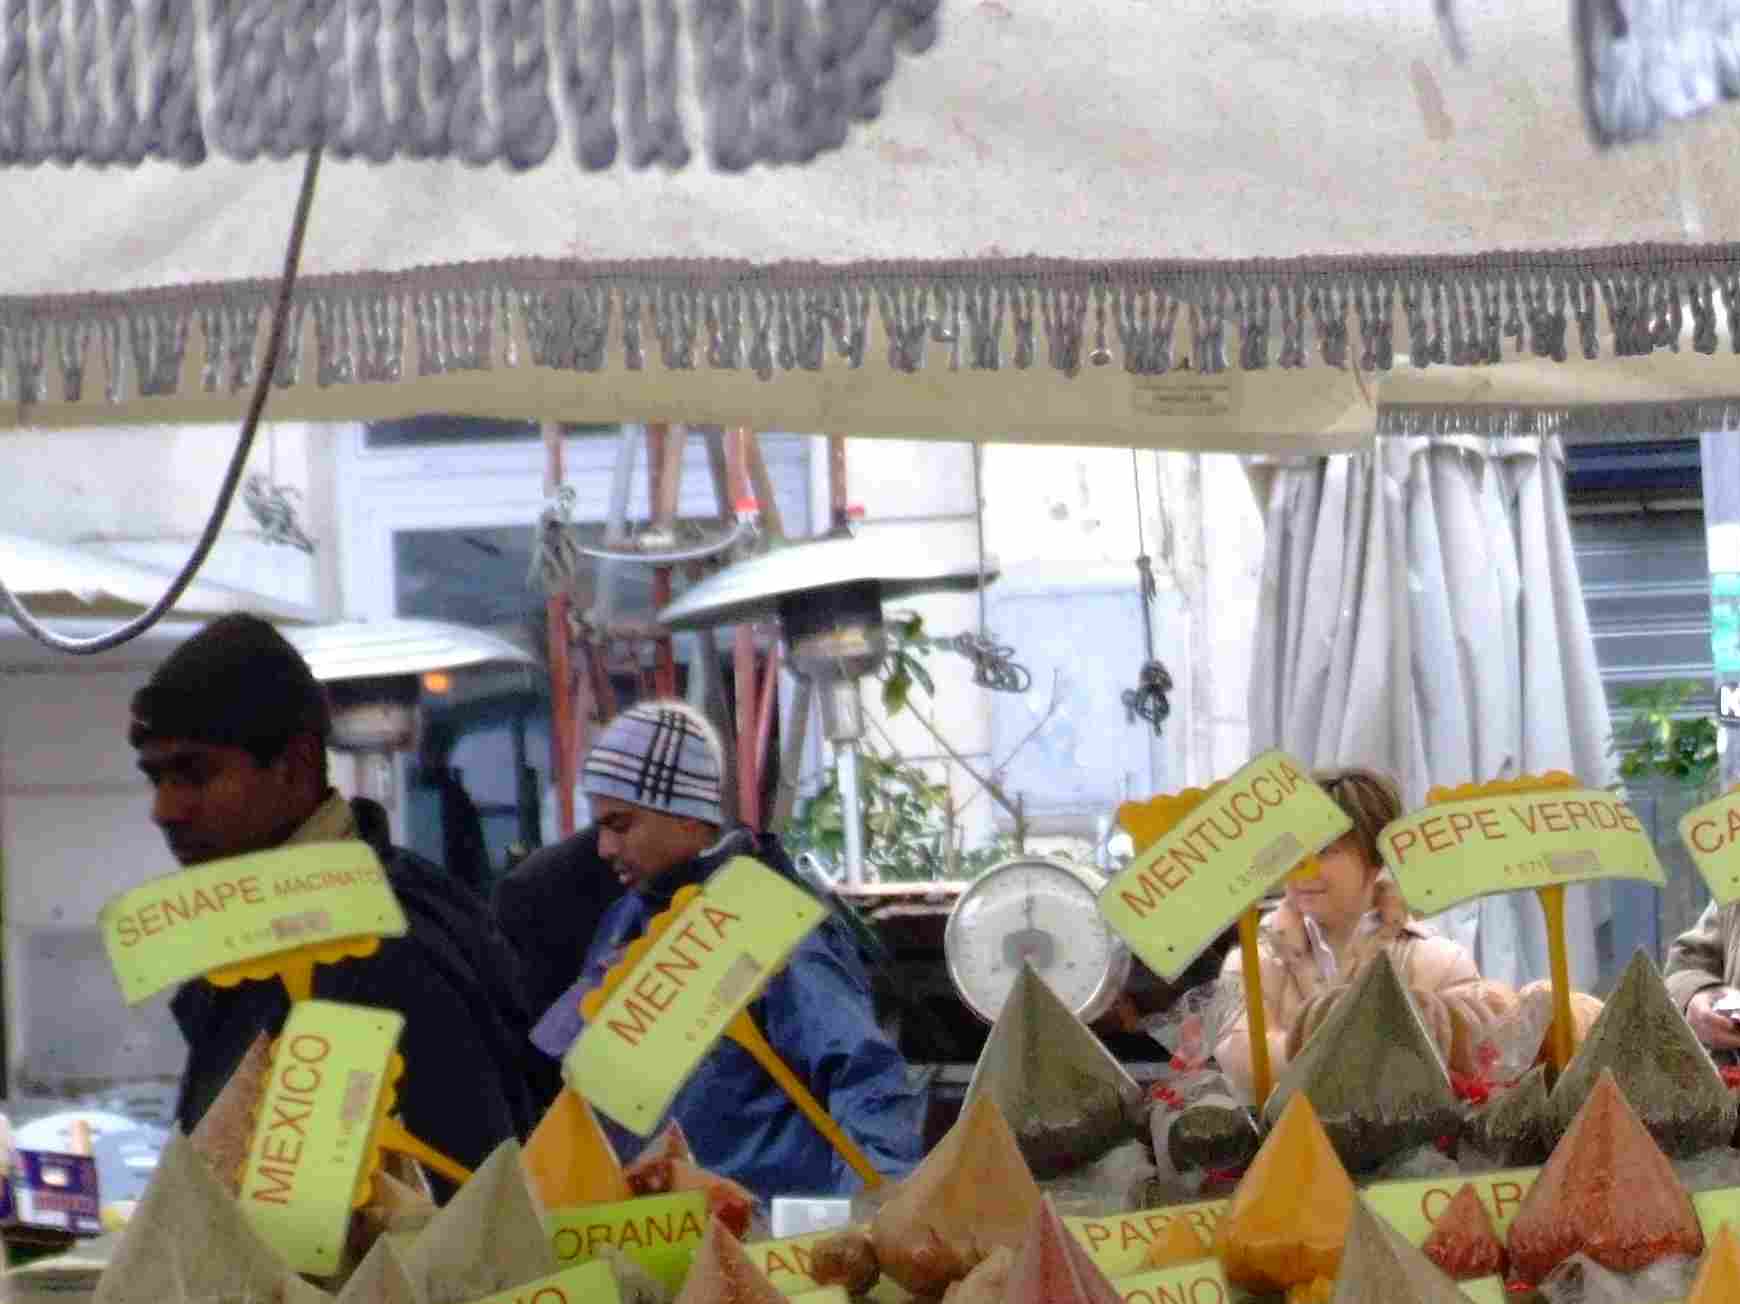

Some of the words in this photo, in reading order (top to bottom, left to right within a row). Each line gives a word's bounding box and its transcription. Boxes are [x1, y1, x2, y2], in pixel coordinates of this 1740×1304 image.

[1119, 759, 1302, 920] MENTUCCIA
[1389, 808, 1508, 865] PEPE
[1508, 799, 1641, 835] VERDE
[115, 875, 265, 948] SENAPE
[606, 905, 741, 1047] MENTA
[252, 1033, 330, 1206] MEXICO
